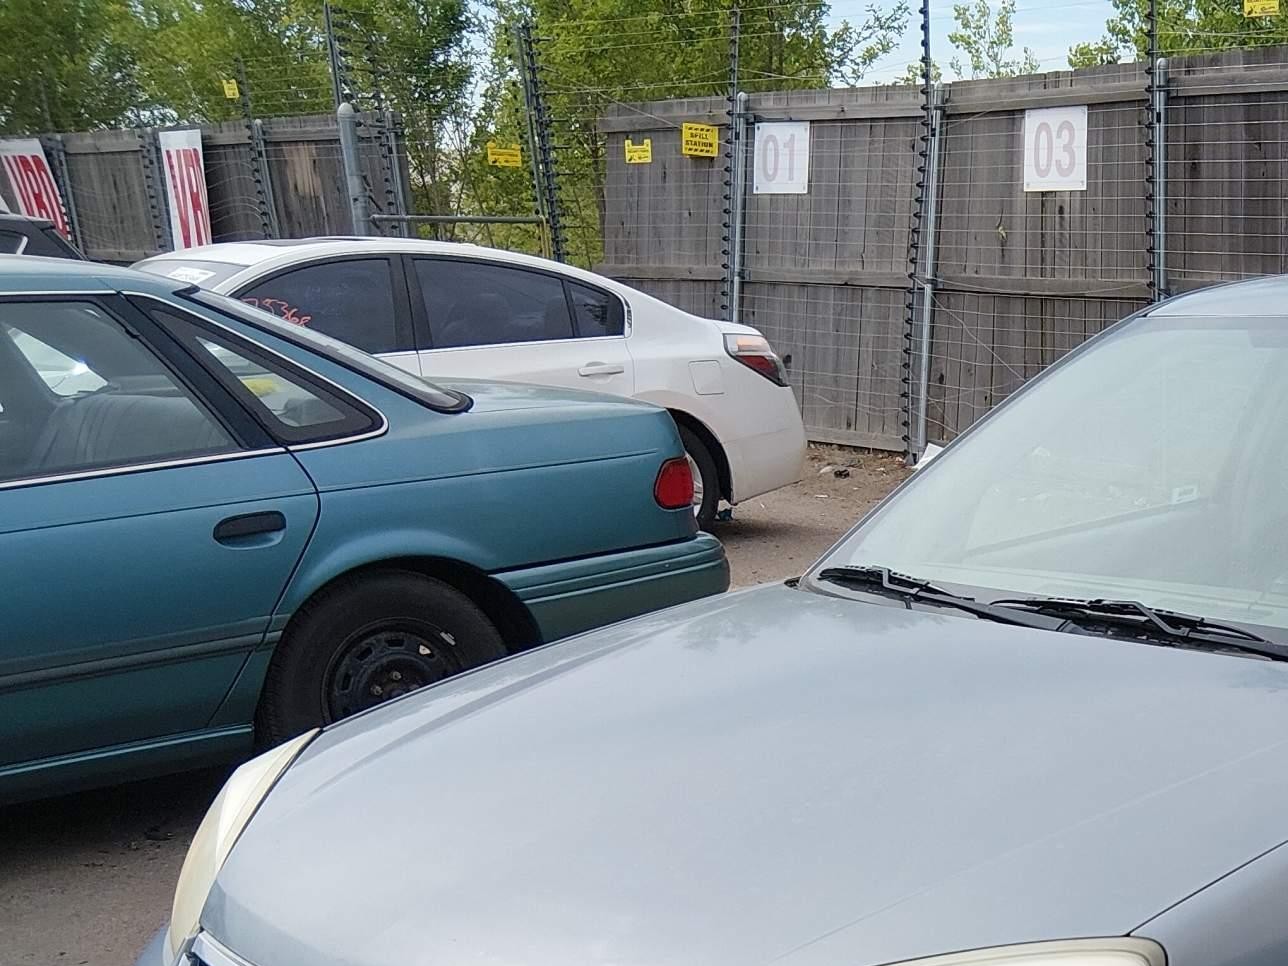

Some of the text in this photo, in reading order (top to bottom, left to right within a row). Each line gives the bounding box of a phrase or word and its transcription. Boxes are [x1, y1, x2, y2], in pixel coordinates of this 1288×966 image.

[684, 140, 713, 148] STATION
[690, 132, 708, 140] SPILL
[1033, 120, 1076, 178] 03
[761, 133, 795, 182] 01
